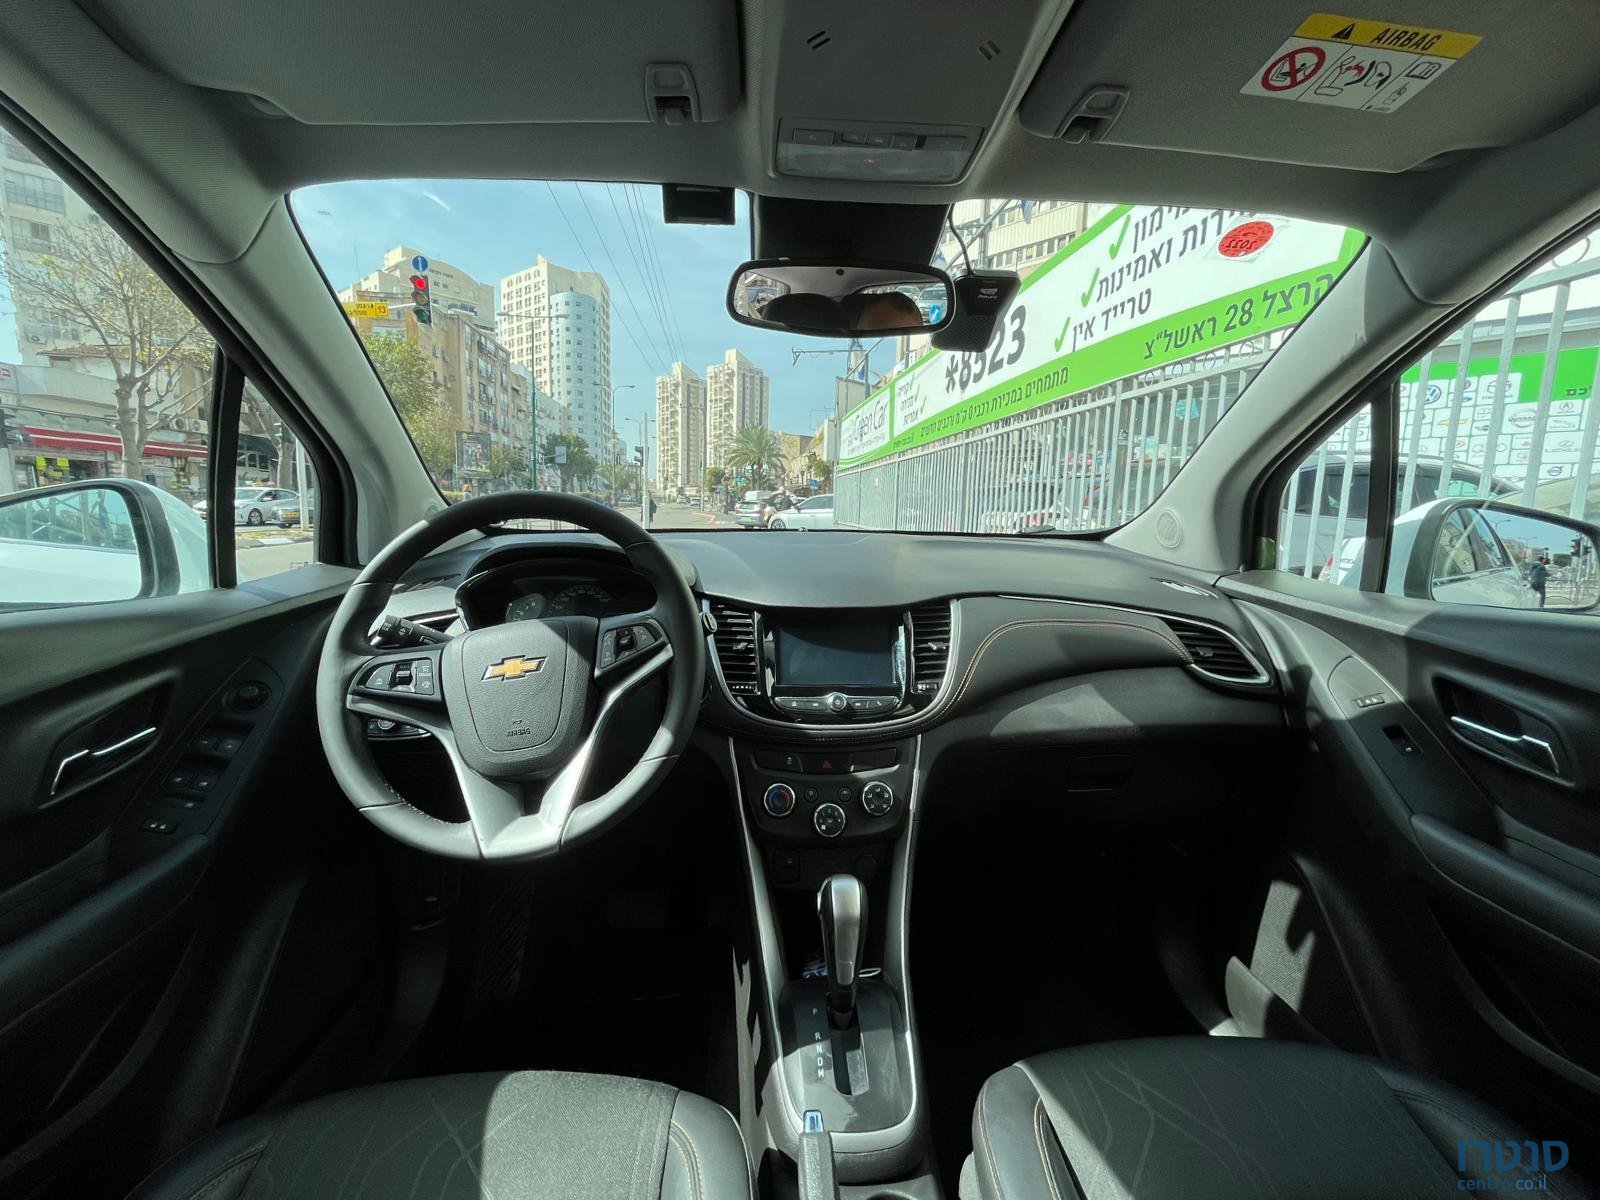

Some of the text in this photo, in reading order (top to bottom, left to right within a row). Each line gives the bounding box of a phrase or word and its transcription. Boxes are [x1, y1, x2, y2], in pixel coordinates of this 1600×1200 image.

[1370, 28, 1441, 50] AIRBAG
[1097, 238, 1173, 302] ואמינות
[1263, 273, 1334, 320] הרצל
[1072, 288, 1152, 352] טרייד אין
[1223, 298, 1254, 332] 28
[1025, 366, 1069, 398] מתמחים
[990, 387, 1023, 412] במכירת
[507, 728, 531, 738] AIRBAG
[812, 1008, 818, 1016] P
[815, 1032, 821, 1040] R
[816, 1044, 822, 1053] N
[817, 1057, 824, 1066] D
[818, 1068, 824, 1077] M
